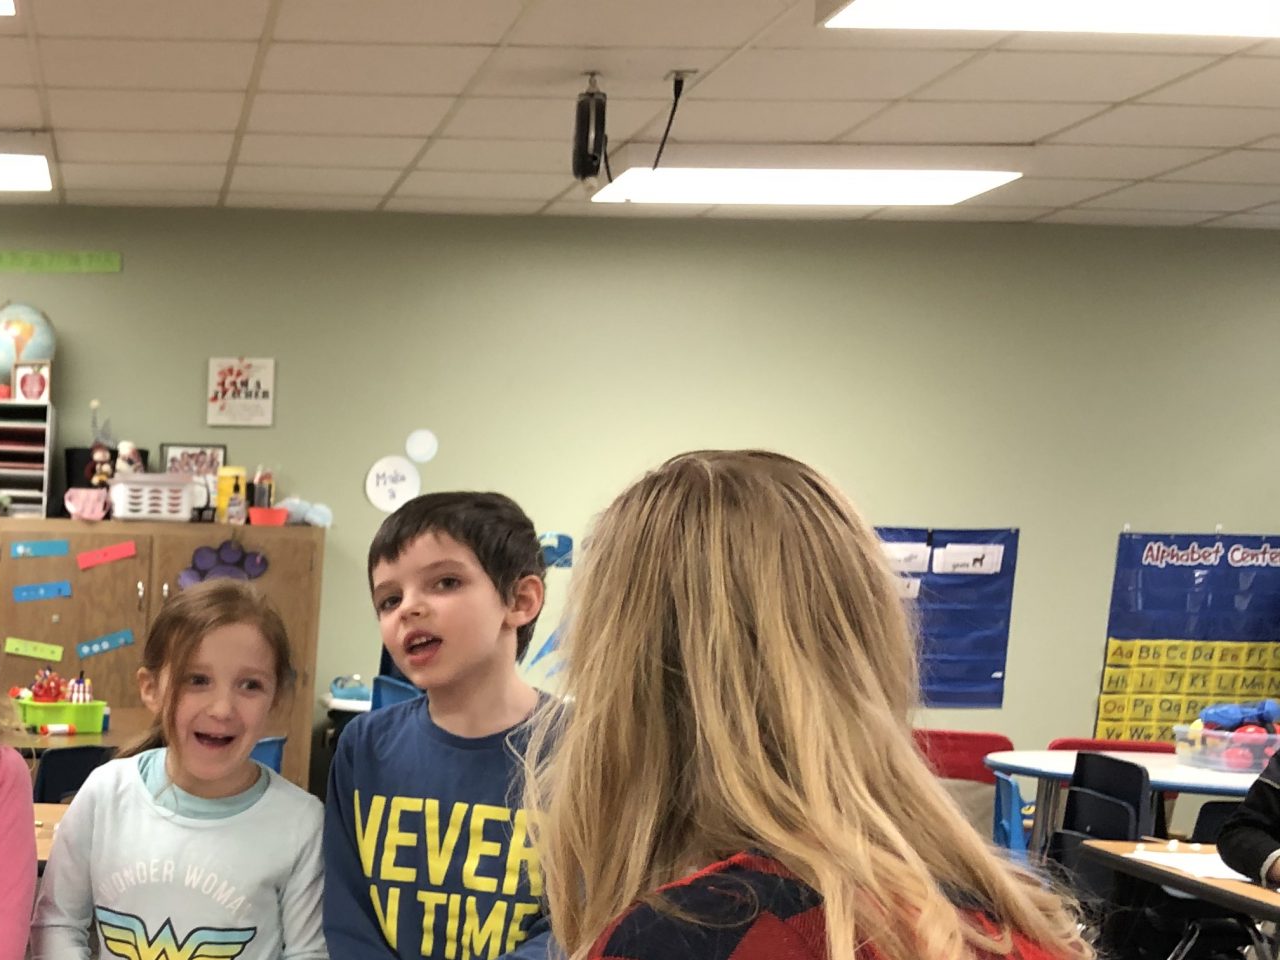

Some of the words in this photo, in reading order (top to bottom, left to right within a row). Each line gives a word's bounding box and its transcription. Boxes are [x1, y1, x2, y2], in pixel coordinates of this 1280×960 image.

[1142, 541, 1224, 568] Alphabet
[1228, 543, 1280, 567] Cente
[1111, 646, 1133, 660] Aa
[1138, 645, 1161, 660] Bb
[1166, 645, 1187, 660] Cc
[1192, 645, 1214, 661] Dd
[1219, 647, 1240, 662] Ee
[1106, 674, 1128, 689] Hh
[1164, 672, 1182, 690] Jj
[1103, 701, 1125, 714] Oo
[1132, 700, 1153, 717] Pp
[1159, 700, 1182, 717] Qq
[354, 789, 544, 896] NEVER
[97, 858, 176, 902] WONDER
